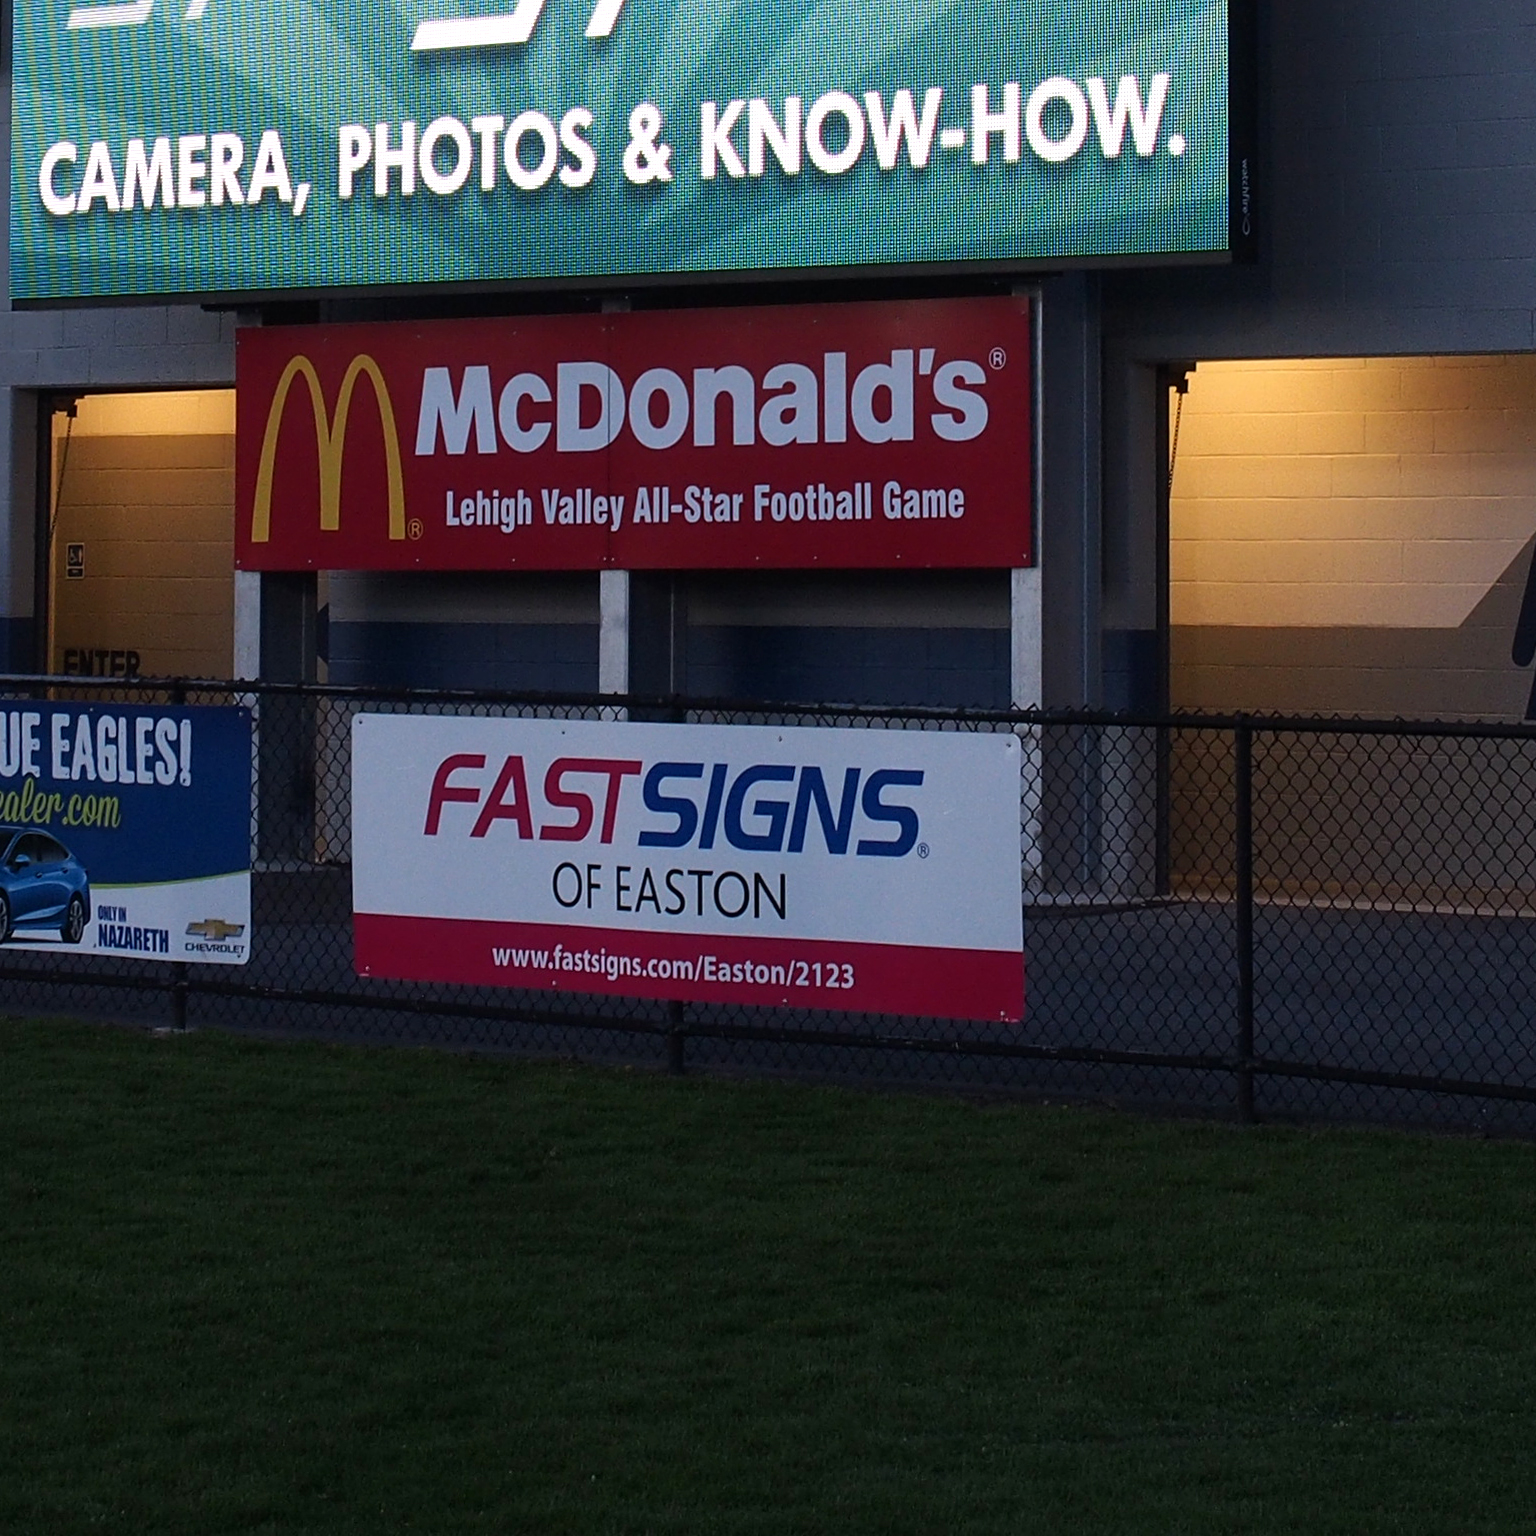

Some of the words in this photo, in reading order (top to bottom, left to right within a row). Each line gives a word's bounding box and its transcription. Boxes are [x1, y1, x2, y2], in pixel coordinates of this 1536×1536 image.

[38, 133, 312, 219] CAMERA,
[337, 102, 593, 199] PHOTOS
[623, 104, 674, 185] &
[700, 73, 1188, 180] KNOW-HOW.
[414, 348, 989, 456] McDonald's
[445, 490, 534, 529] Lehigh
[541, 487, 624, 533] Valley
[633, 484, 744, 525] All-Star
[754, 481, 872, 523] Football
[883, 480, 965, 520] Game
[64, 649, 141, 678] ENTER
[52, 713, 192, 787] EAGLES!
[423, 753, 925, 858] FASTSIGNS
[98, 905, 116, 920] ONLY
[118, 906, 127, 923] IN
[553, 863, 602, 909] OF
[615, 866, 786, 920] EASTON
[98, 924, 169, 953] NAZARETH
[185, 943, 244, 954] CHEVROLET
[492, 944, 855, 990] www.fastsigns.com/Easton/2123
